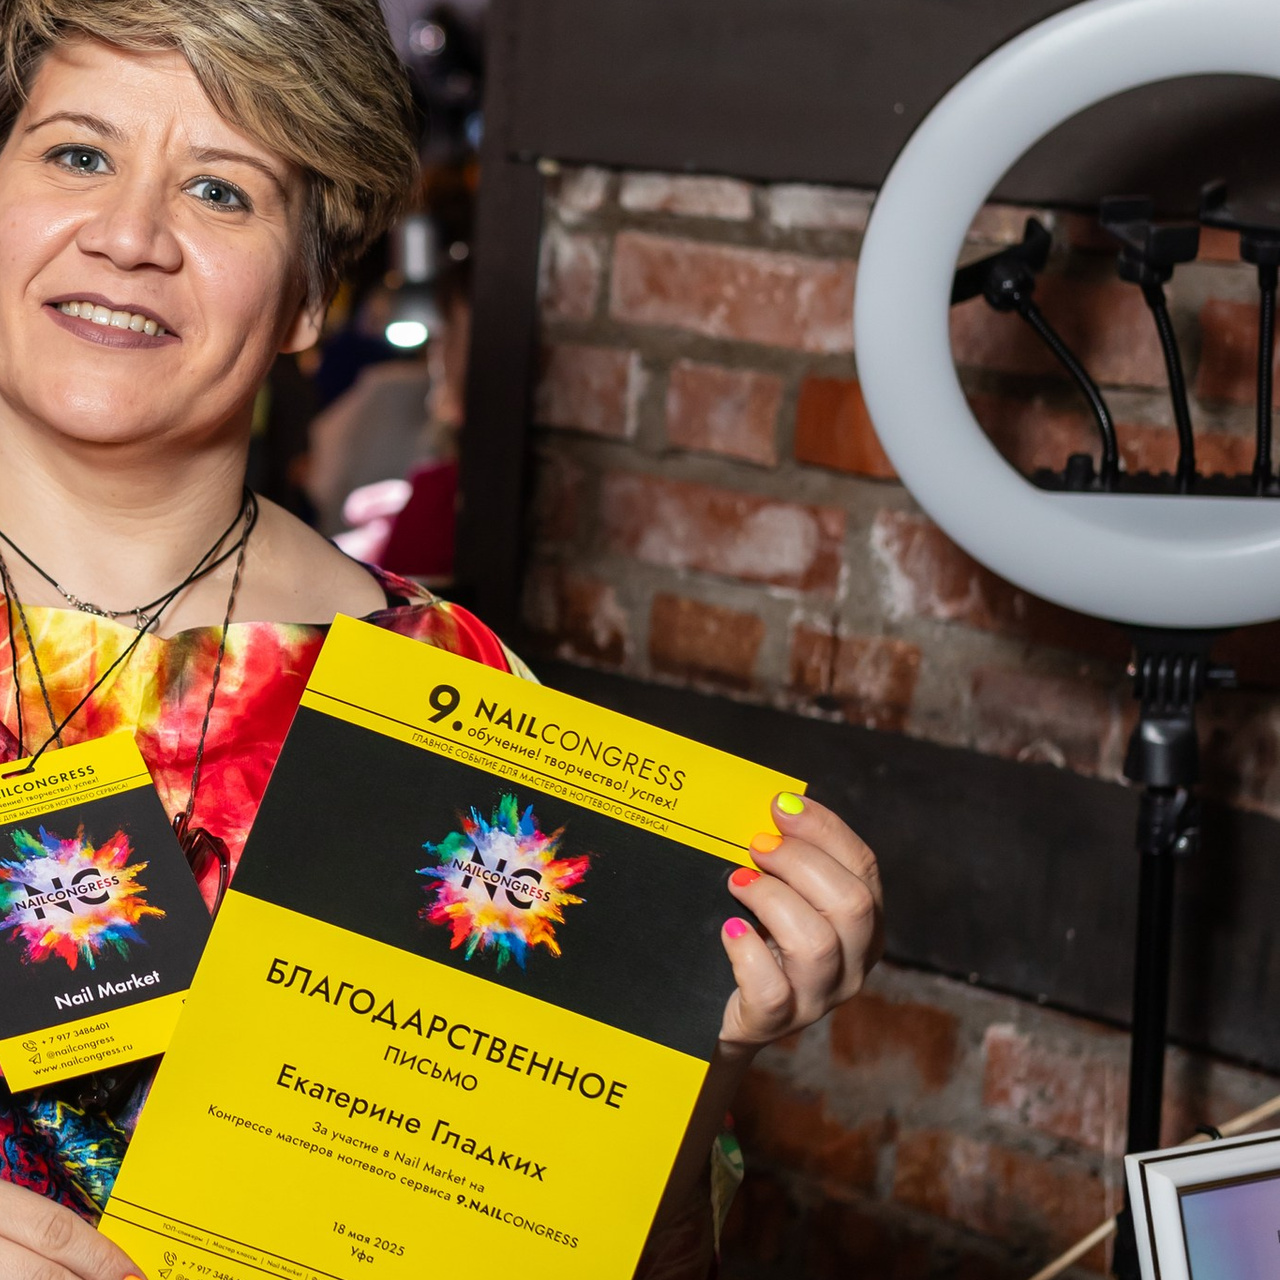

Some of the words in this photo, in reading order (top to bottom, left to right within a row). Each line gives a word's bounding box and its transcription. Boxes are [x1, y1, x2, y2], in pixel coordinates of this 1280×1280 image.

[428, 685, 462, 731] 9.
[475, 698, 686, 790] NAILCONGRESS
[25, 783, 73, 802] творчество!
[73, 776, 100, 791] успех!
[411, 732, 455, 755] ГЛАВНОЕ
[454, 748, 499, 771] СОБЫТИЕ
[497, 764, 519, 778] ДЛЯ
[518, 772, 568, 796] МАСТЕРОВ
[568, 789, 623, 816] НОГТЕВОГО
[623, 810, 669, 833] СЕРВИСА!
[468, 728, 541, 760] обучение!
[545, 755, 628, 792] творчество!
[628, 786, 678, 811] успех!
[3, 812, 18, 822] ДЛЯ
[18, 803, 58, 817] МАСТЕРОВ
[54, 792, 99, 808] НОГТЕВОГО
[95, 782, 129, 796] СЕРВИСА!
[15, 876, 120, 911] NAILCONGRESS
[452, 858, 551, 902] NAILCONGRESS
[54, 985, 95, 1010] Nail
[97, 970, 161, 999] Market
[46, 1035, 115, 1059] @nailcongress
[48, 1036, 54, 1044] 7
[56, 1031, 71, 1042] 917
[72, 1021, 110, 1038] 3486401
[267, 958, 627, 1109] БЛАГОДАРСТВЕННОЕ
[33, 1045, 133, 1075] www.nailcongress.ru
[384, 1046, 477, 1091] ПИСЬМО
[277, 1064, 420, 1133] Екатерине
[431, 1120, 547, 1181] Гладких
[208, 1104, 272, 1135] Конгрессе
[275, 1132, 334, 1158] мастеров
[336, 1153, 397, 1181] ногтевого
[399, 1176, 452, 1202] сервиса
[457, 1195, 578, 1248] 9.NAILCONGRESS
[311, 1121, 328, 1136] За
[330, 1130, 379, 1154] участие
[382, 1149, 390, 1158] в
[393, 1150, 421, 1169] Nail
[422, 1161, 467, 1186] Market
[468, 1181, 485, 1194] на
[332, 1221, 346, 1235] 18
[347, 1230, 371, 1245] мая
[373, 1236, 406, 1257] 2025
[350, 1245, 375, 1264] Уфа
[188, 1261, 196, 1270] 7
[196, 1264, 212, 1275] 917
[266, 1259, 281, 1269] Nail
[280, 1265, 303, 1277] Market
